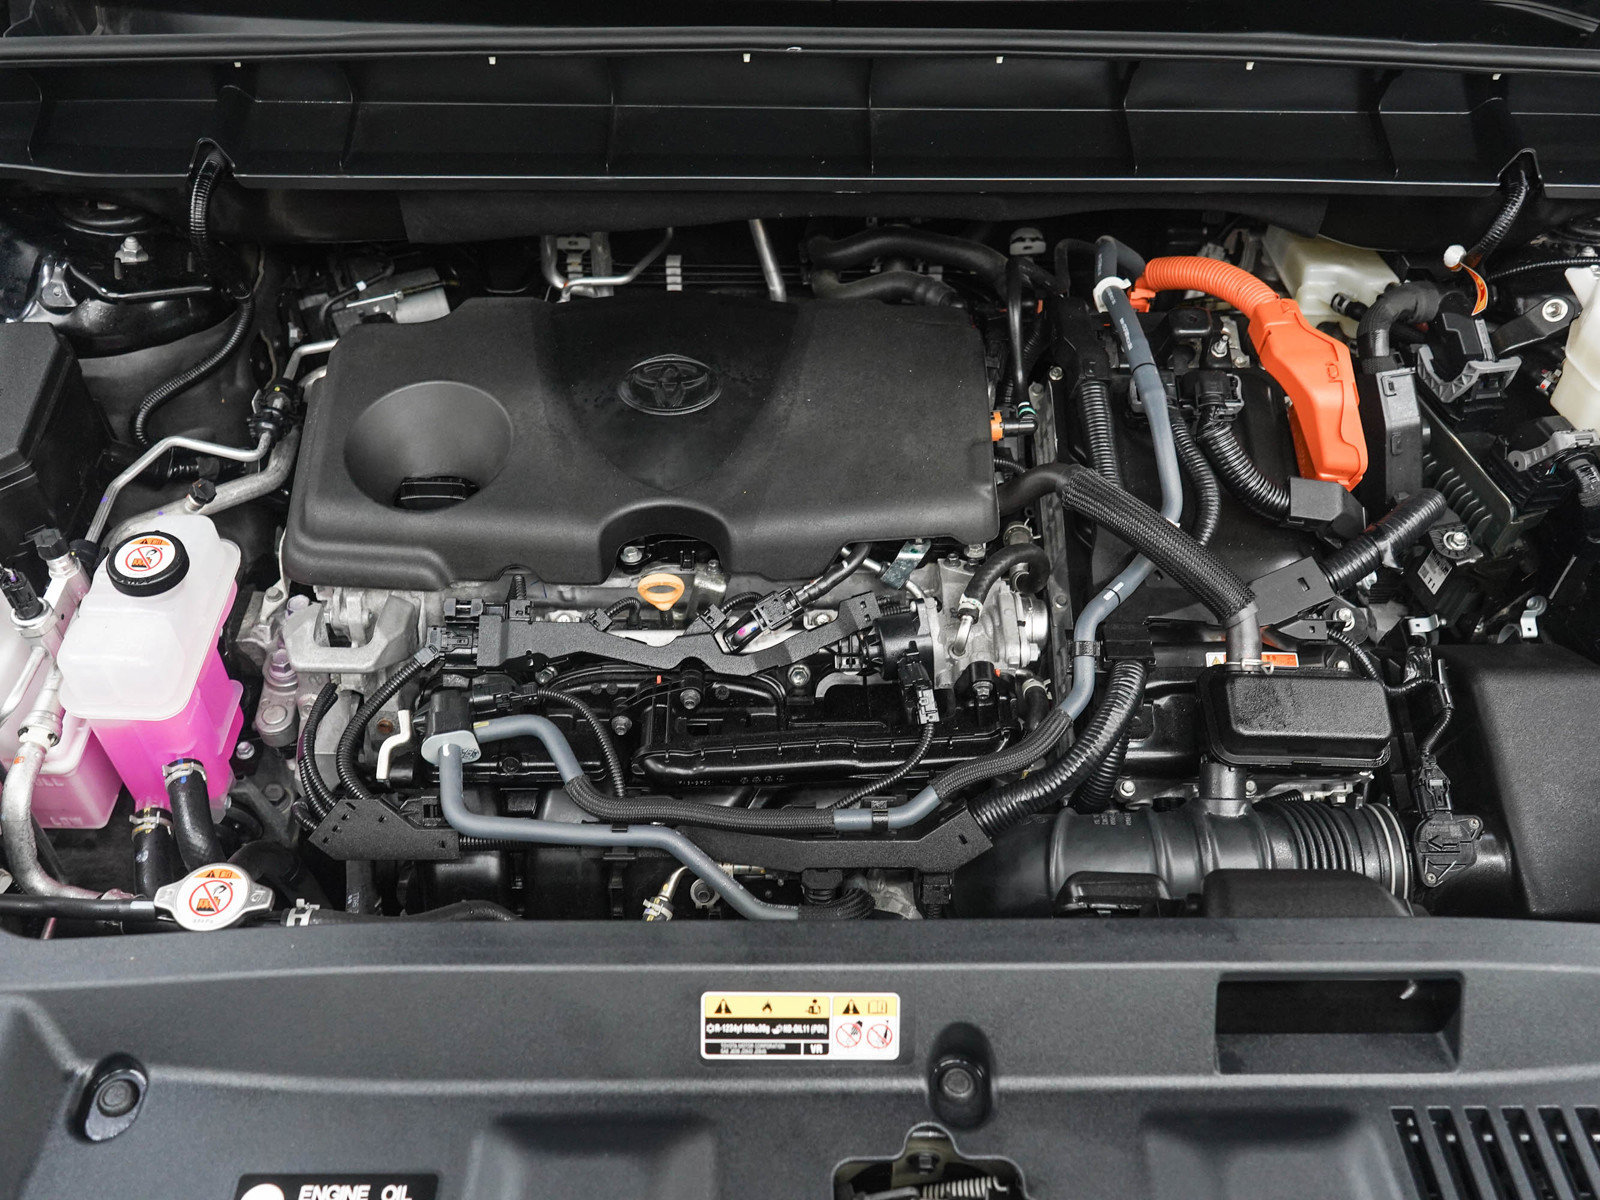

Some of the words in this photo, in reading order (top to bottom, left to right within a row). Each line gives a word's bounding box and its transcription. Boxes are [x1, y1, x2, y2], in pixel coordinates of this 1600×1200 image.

[34, 777, 64, 787] ULL
[50, 816, 84, 826] LOW
[809, 1043, 823, 1055] VR
[298, 1184, 372, 1200] ENGINE
[380, 1184, 413, 1200] OIL
